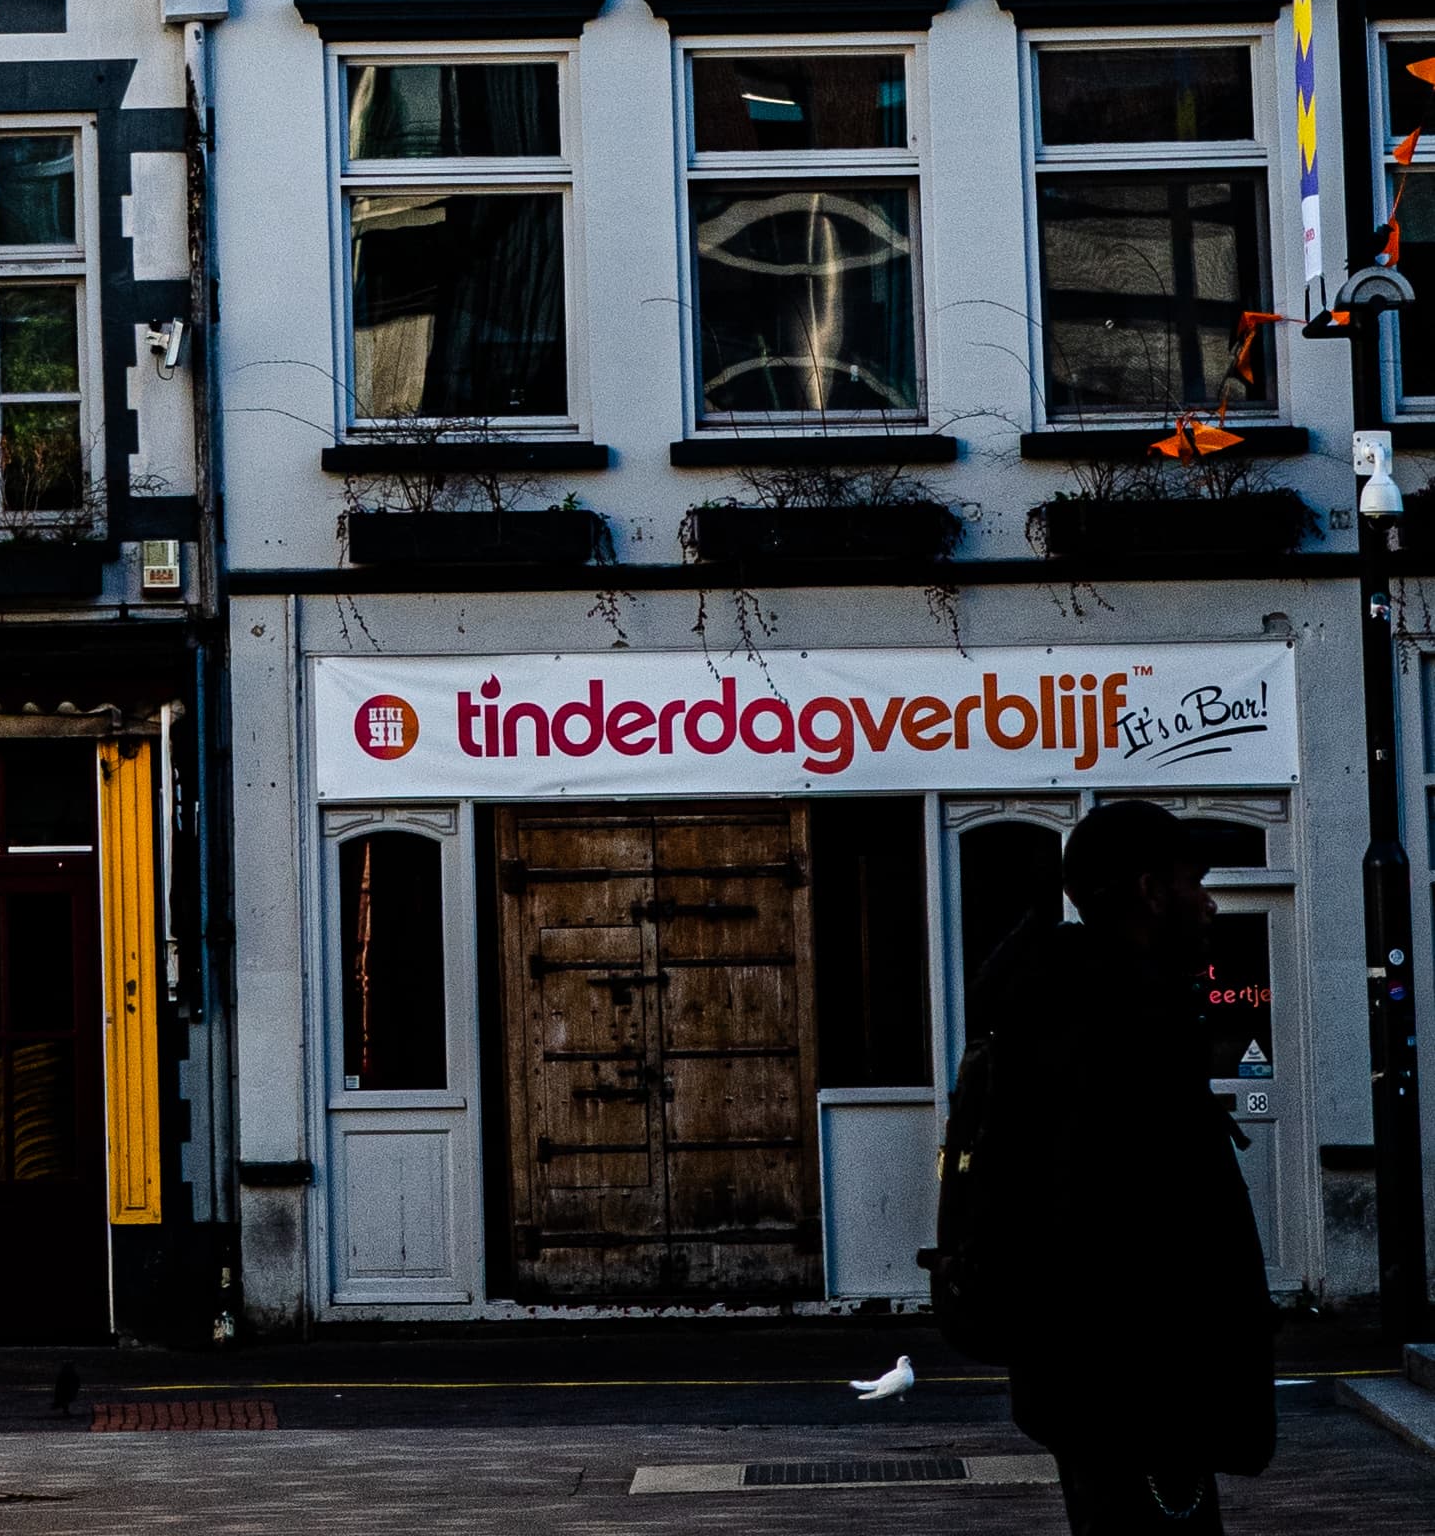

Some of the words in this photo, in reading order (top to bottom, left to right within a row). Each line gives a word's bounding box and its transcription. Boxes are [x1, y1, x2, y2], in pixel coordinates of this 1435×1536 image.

[1180, 680, 1268, 728] Bar!
[456, 673, 1128, 775] tinderdagverblijf
[1111, 706, 1170, 761] It's
[1174, 712, 1193, 734] a
[1208, 984, 1271, 1008] eertje
[1249, 1094, 1267, 1112] 38
